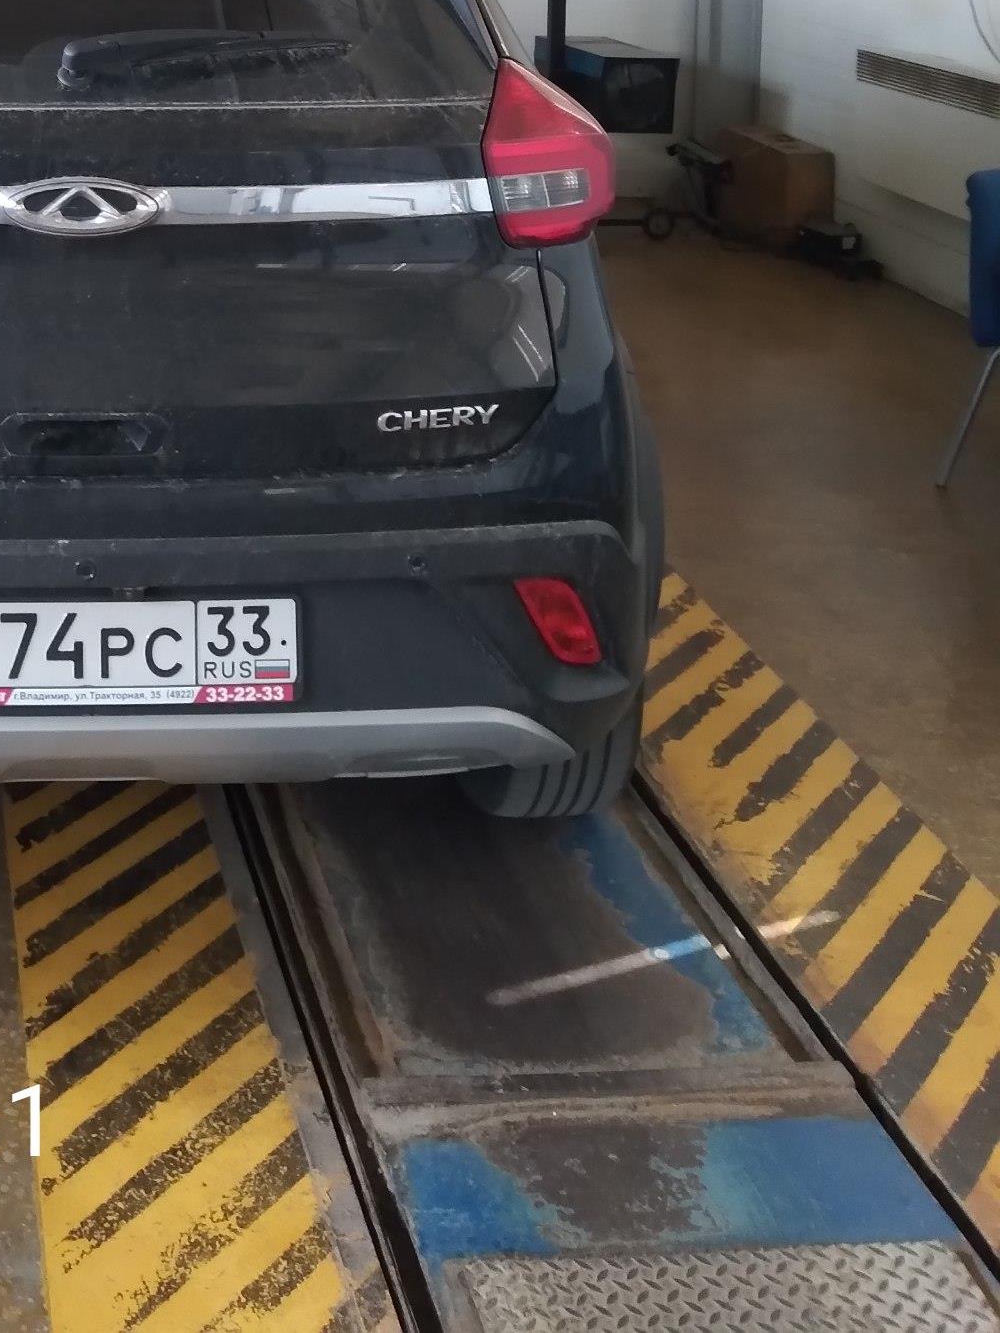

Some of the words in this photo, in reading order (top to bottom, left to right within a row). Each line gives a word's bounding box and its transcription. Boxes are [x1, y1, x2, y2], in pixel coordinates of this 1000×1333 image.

[377, 404, 500, 432] CHERY
[207, 605, 271, 657] 33
[204, 660, 252, 679] RUS
[205, 685, 285, 703] 33-22-33
